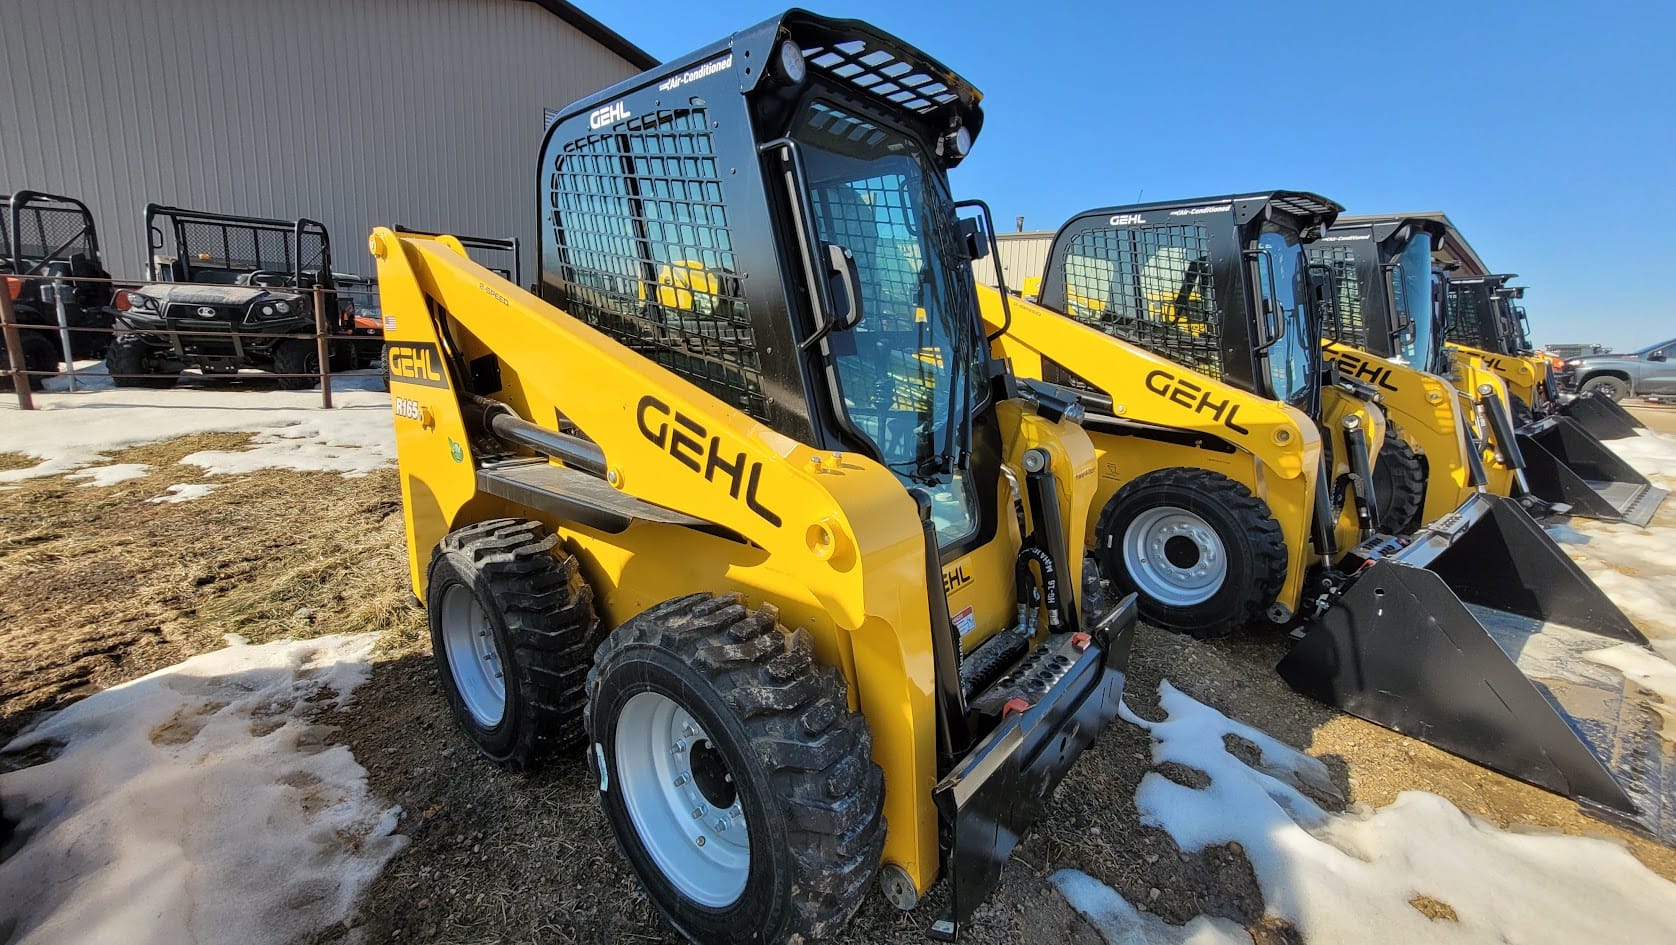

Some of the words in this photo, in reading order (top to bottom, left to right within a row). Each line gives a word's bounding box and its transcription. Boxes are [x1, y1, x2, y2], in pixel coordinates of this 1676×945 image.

[669, 54, 733, 91] Air-Conditioned
[590, 101, 631, 130] GEHL
[1109, 214, 1147, 226] GEHL
[388, 346, 441, 382] GEHL
[1145, 370, 1249, 435] GEHL
[636, 395, 783, 528] GEHL
